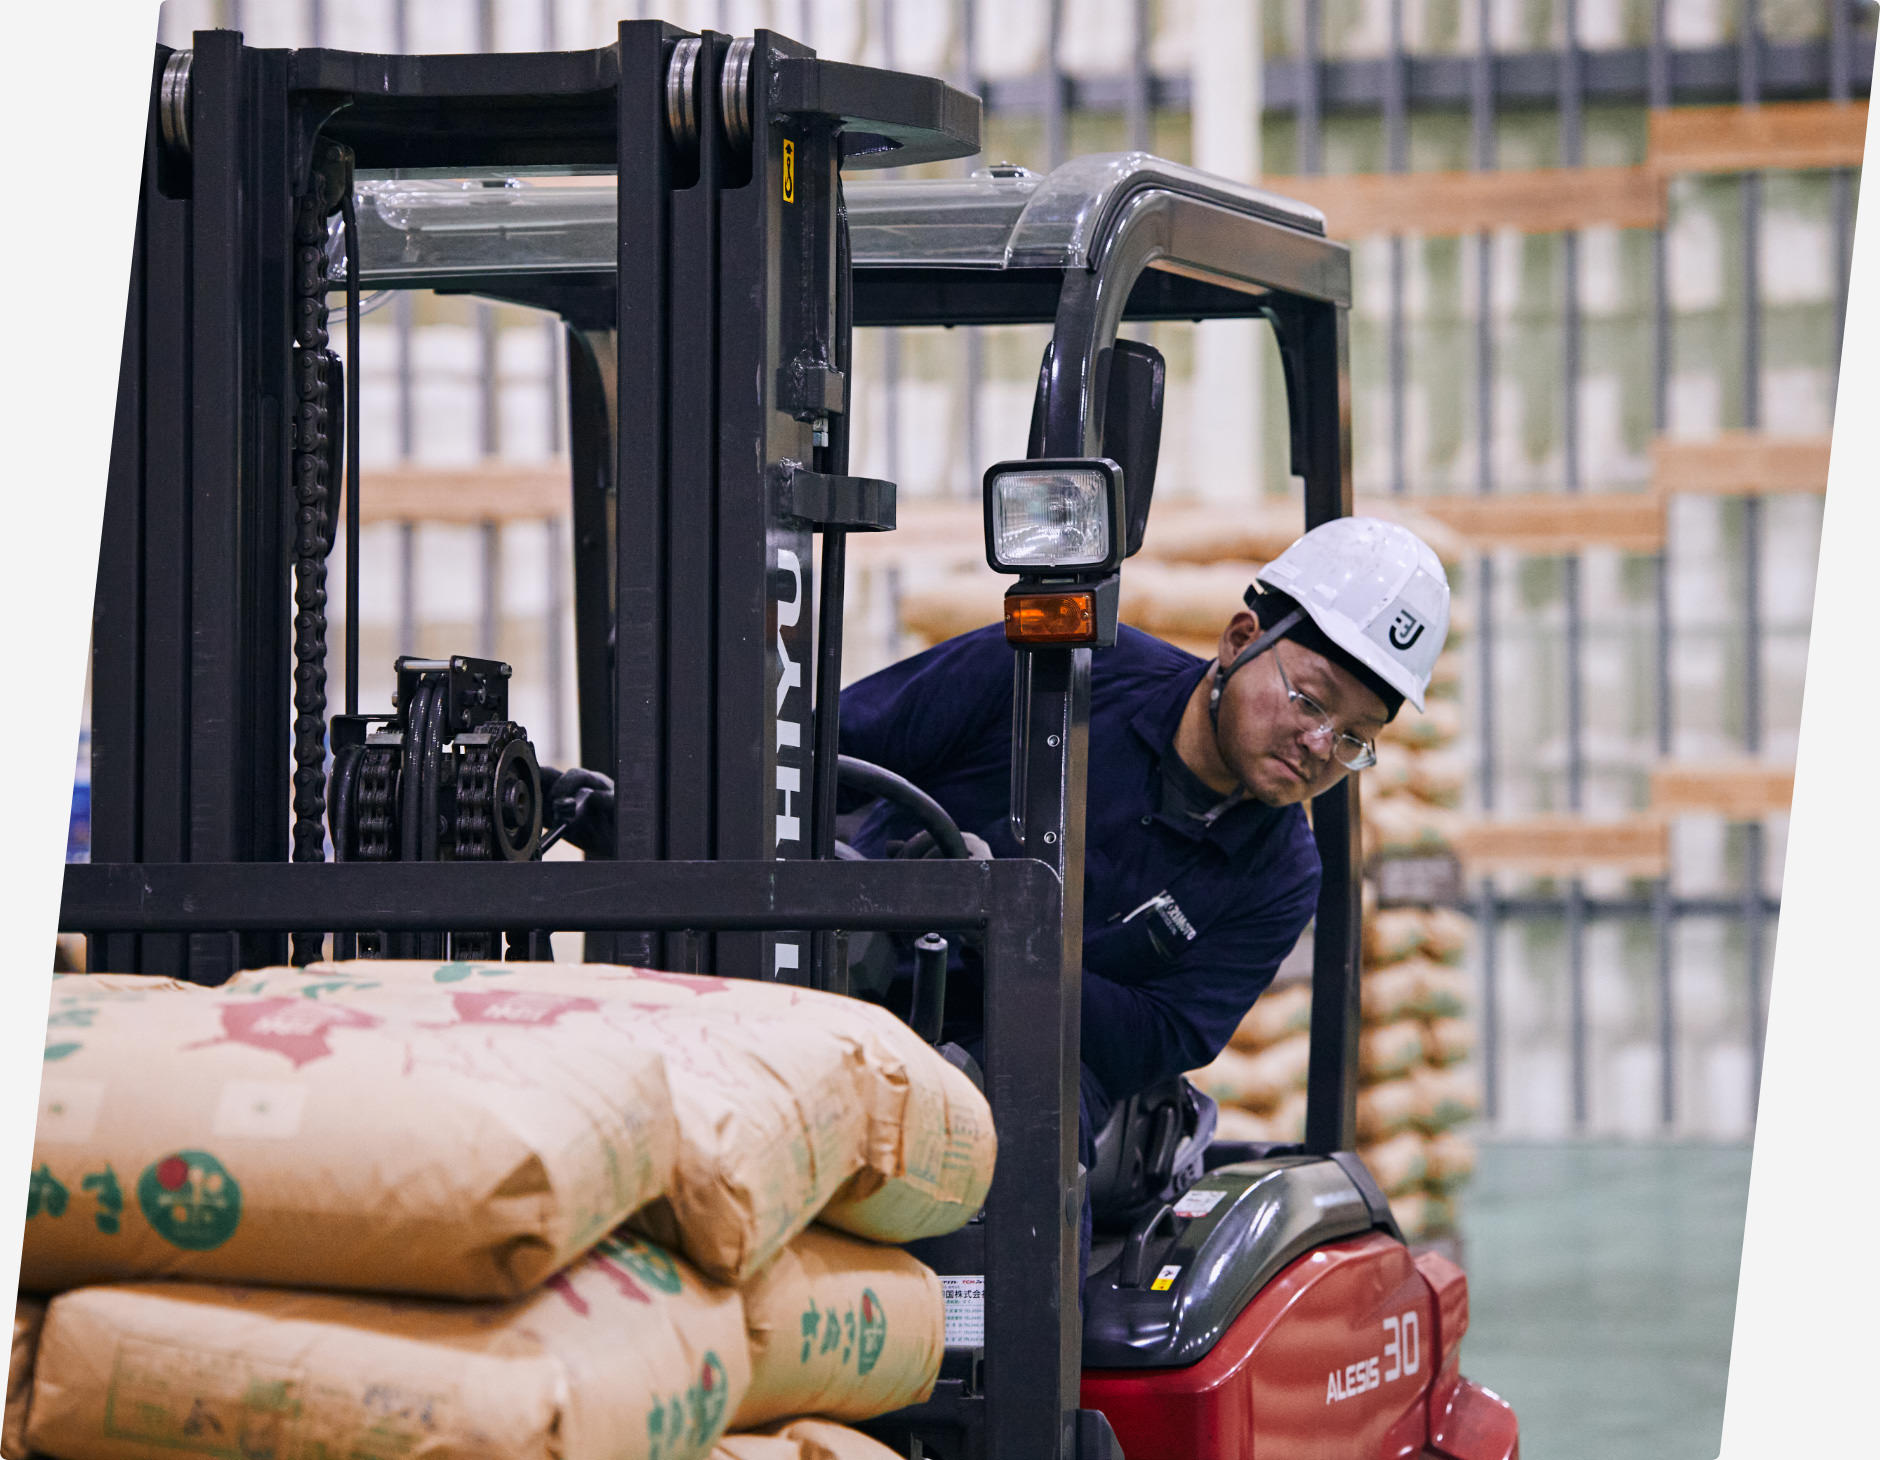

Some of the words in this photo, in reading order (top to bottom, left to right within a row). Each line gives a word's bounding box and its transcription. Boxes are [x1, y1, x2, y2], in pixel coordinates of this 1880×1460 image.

[774, 548, 802, 978] IHIYU
[1326, 1356, 1380, 1406] ALESIS
[1382, 1311, 1420, 1383] 30
